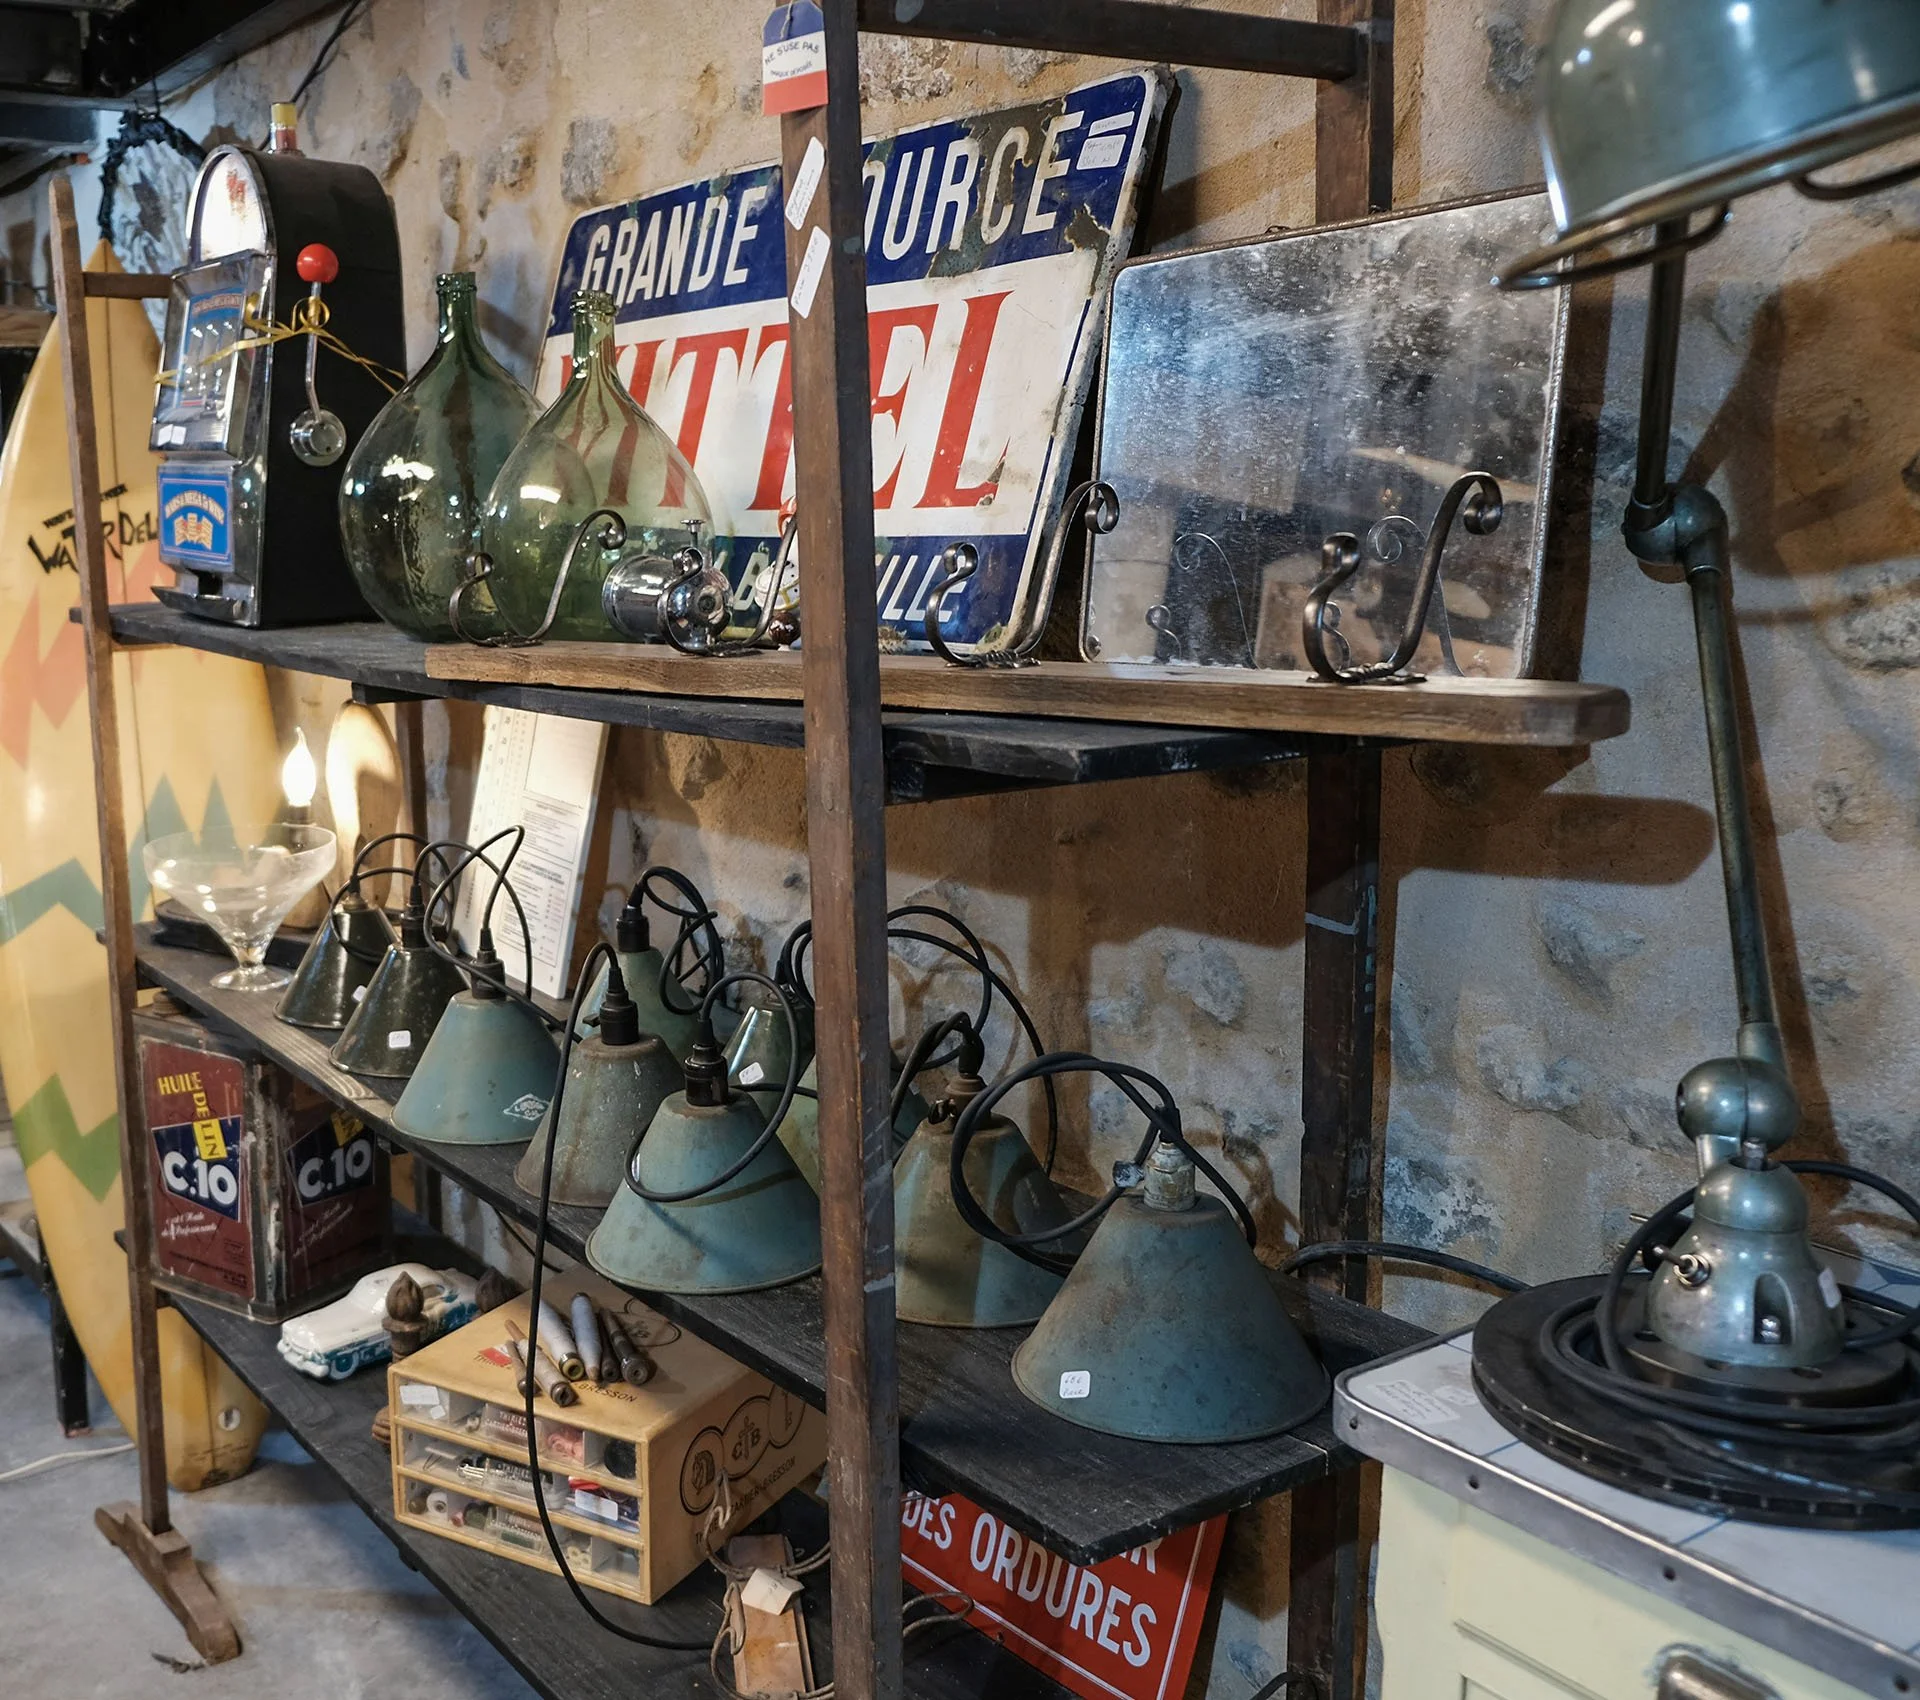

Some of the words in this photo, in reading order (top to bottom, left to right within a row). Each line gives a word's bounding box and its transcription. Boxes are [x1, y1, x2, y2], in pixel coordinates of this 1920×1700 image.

[802, 41, 820, 54] PAS
[581, 186, 767, 306] GRANDE
[157, 1072, 203, 1096] HUILE
[193, 1093, 211, 1118] DE
[200, 1121, 221, 1157] LIN
[163, 1151, 238, 1205] C.10
[298, 1139, 372, 1198] C.10
[902, 1493, 956, 1550] DES
[970, 1512, 1157, 1668] ORDURES
